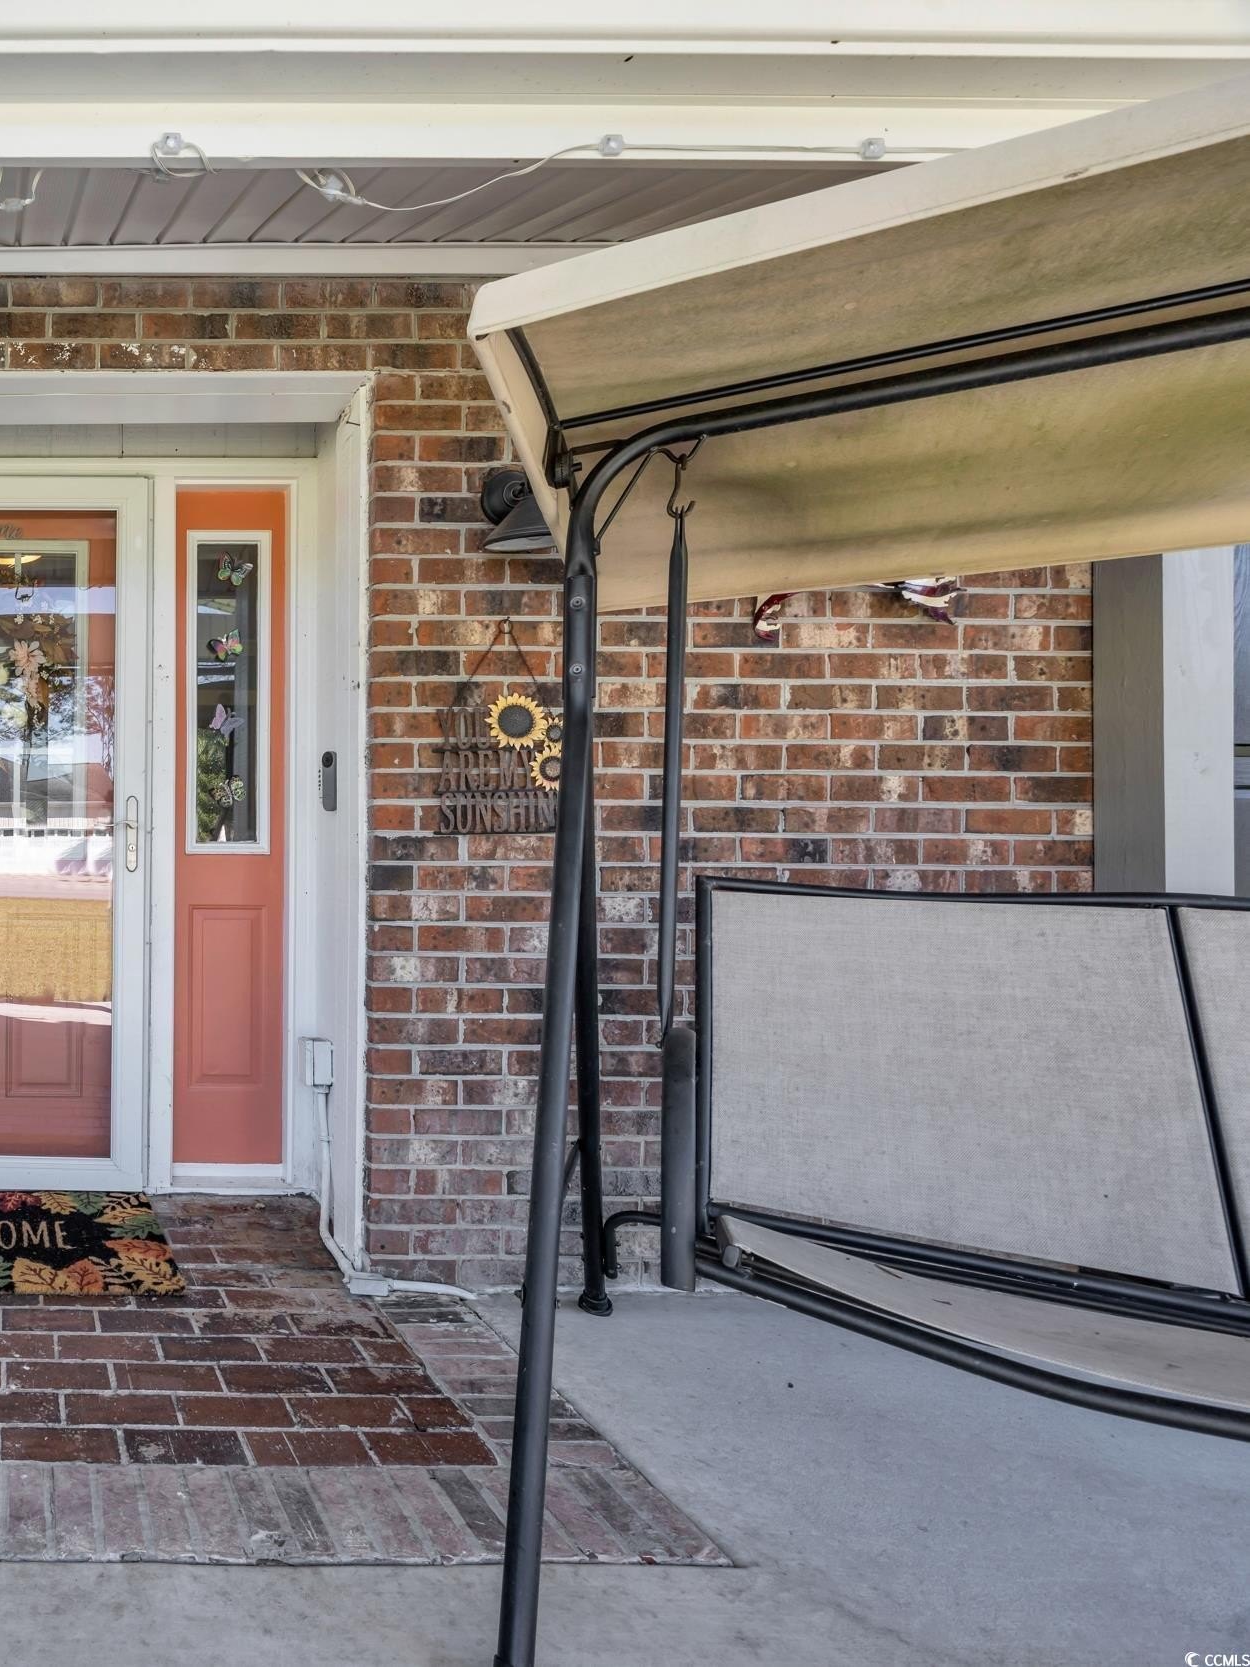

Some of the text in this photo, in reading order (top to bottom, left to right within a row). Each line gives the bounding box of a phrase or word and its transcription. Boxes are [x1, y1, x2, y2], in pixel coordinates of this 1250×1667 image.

[437, 708, 491, 750] YOU
[438, 749, 537, 792] ARE MY
[439, 791, 557, 834] SUNSHIN
